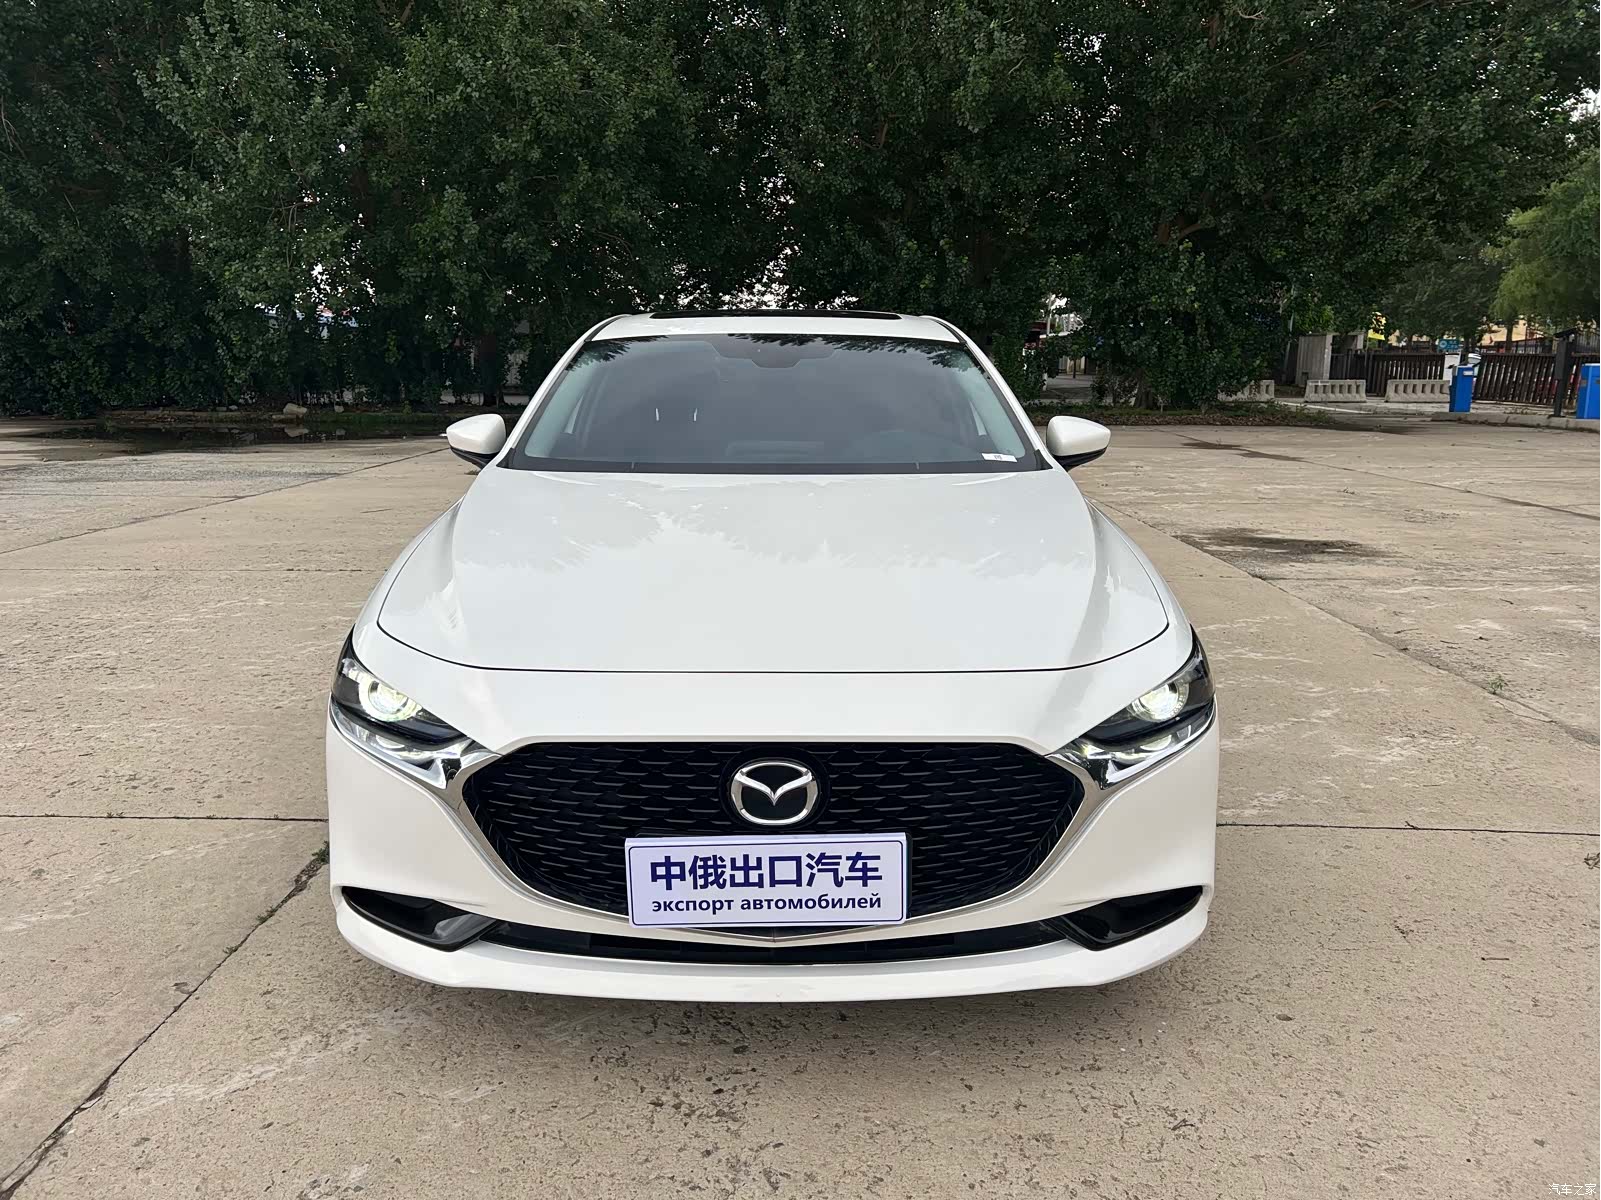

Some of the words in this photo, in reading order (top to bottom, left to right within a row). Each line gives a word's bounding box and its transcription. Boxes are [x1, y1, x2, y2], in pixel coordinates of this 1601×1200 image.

[650, 851, 883, 891] 中俄出口汽车
[651, 899, 735, 915] экспорт
[740, 892, 882, 911] автомобилей
